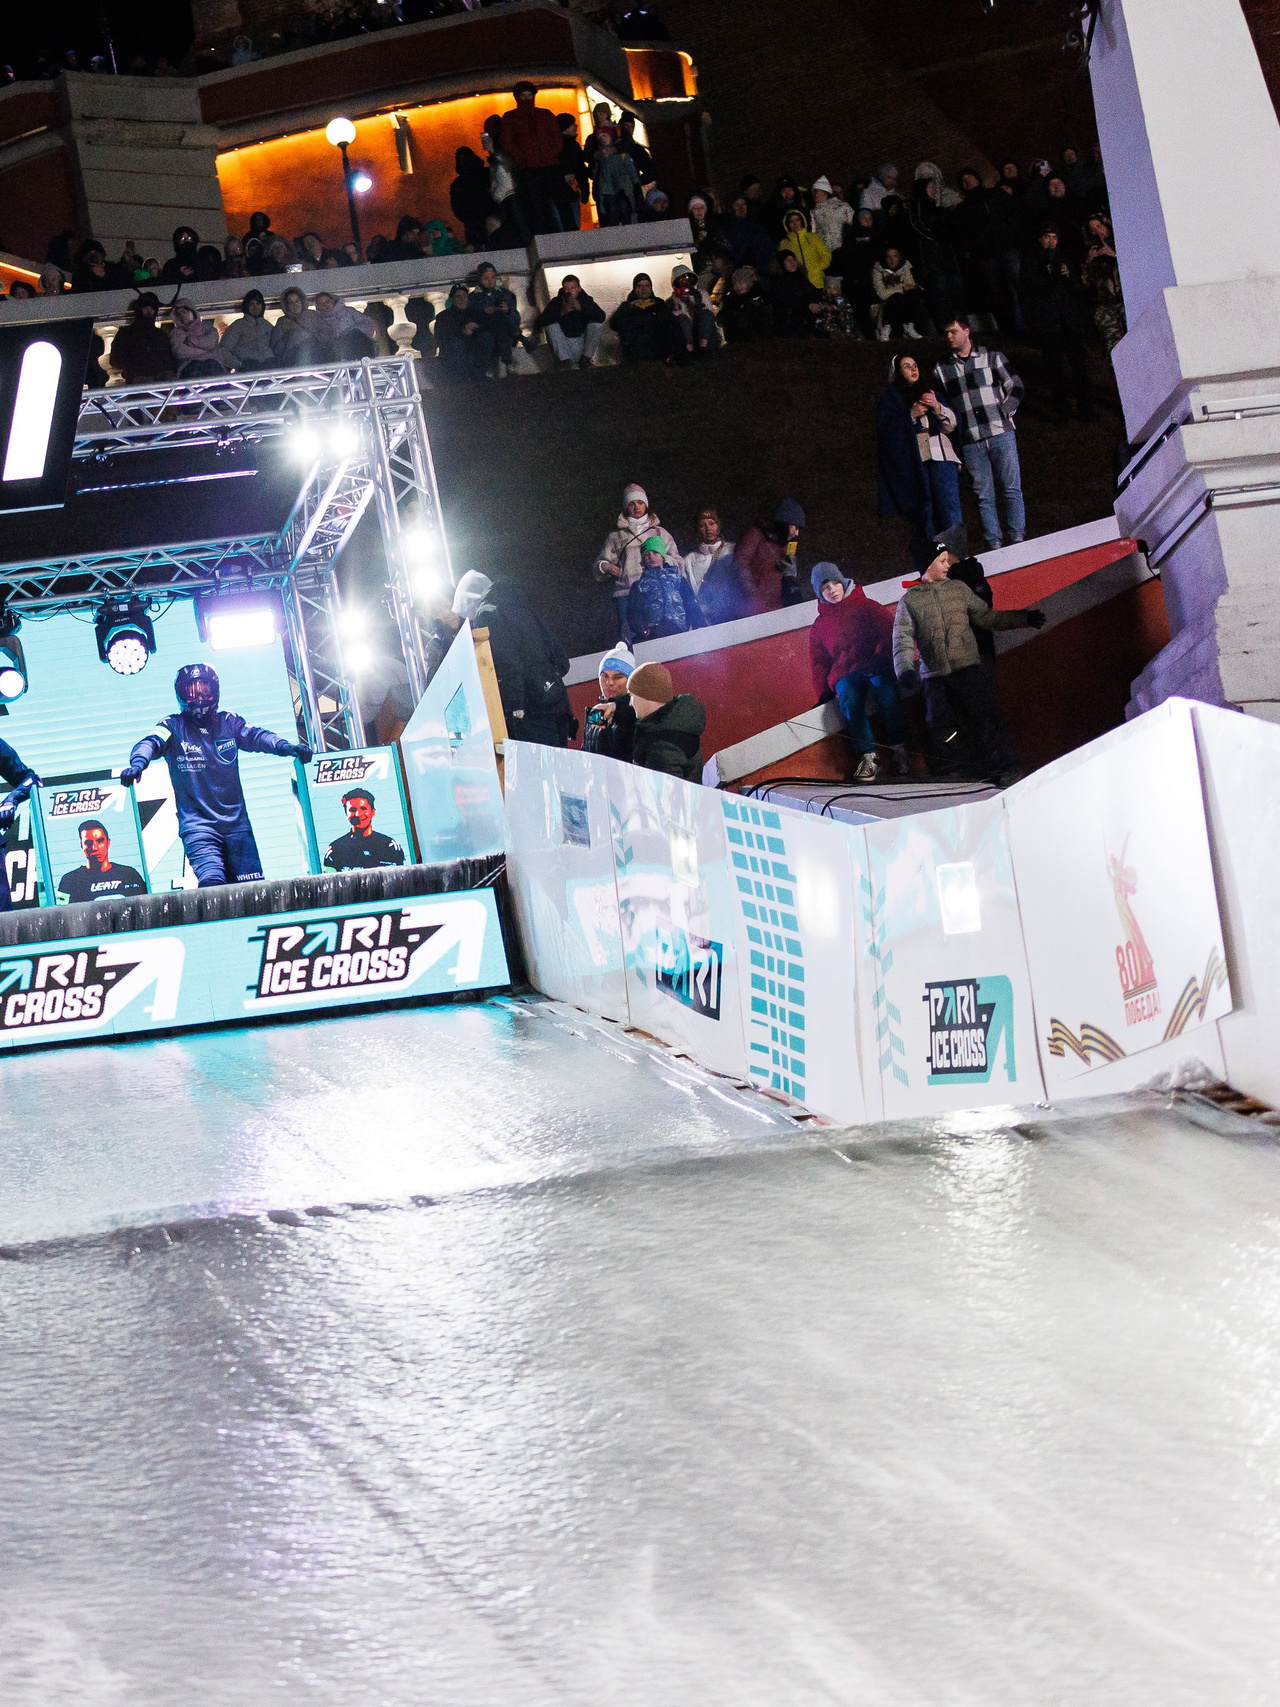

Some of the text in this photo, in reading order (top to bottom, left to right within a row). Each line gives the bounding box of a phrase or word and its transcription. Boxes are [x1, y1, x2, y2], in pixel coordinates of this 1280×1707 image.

[319, 757, 360, 771] PARI
[317, 767, 366, 783] ICE CROSS
[54, 789, 96, 805] PARI
[52, 799, 102, 815] ICE CROSS
[236, 872, 265, 881] WHITEL
[90, 880, 122, 893] LEATT
[265, 913, 392, 961] PARI
[261, 946, 408, 995] ICE CROSS
[3, 983, 104, 1027] CROSS
[929, 983, 976, 1026] PARI
[931, 1027, 987, 1069] ICE CROSS
